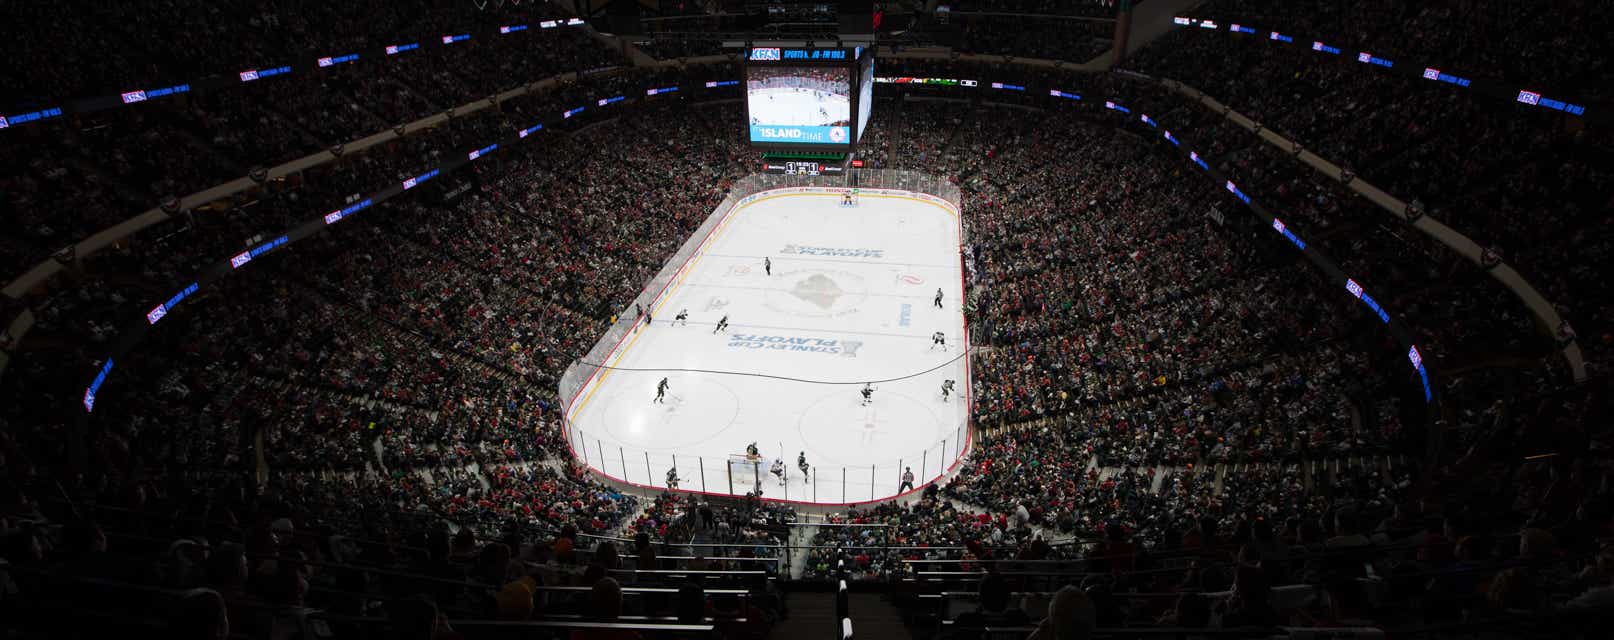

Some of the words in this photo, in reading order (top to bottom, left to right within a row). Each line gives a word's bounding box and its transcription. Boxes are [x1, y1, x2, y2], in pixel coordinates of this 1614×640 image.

[751, 48, 780, 60] KFAN
[762, 128, 800, 138] ISLAND
[731, 334, 838, 346] PLAYOFFS
[766, 344, 840, 353] STANLEY
